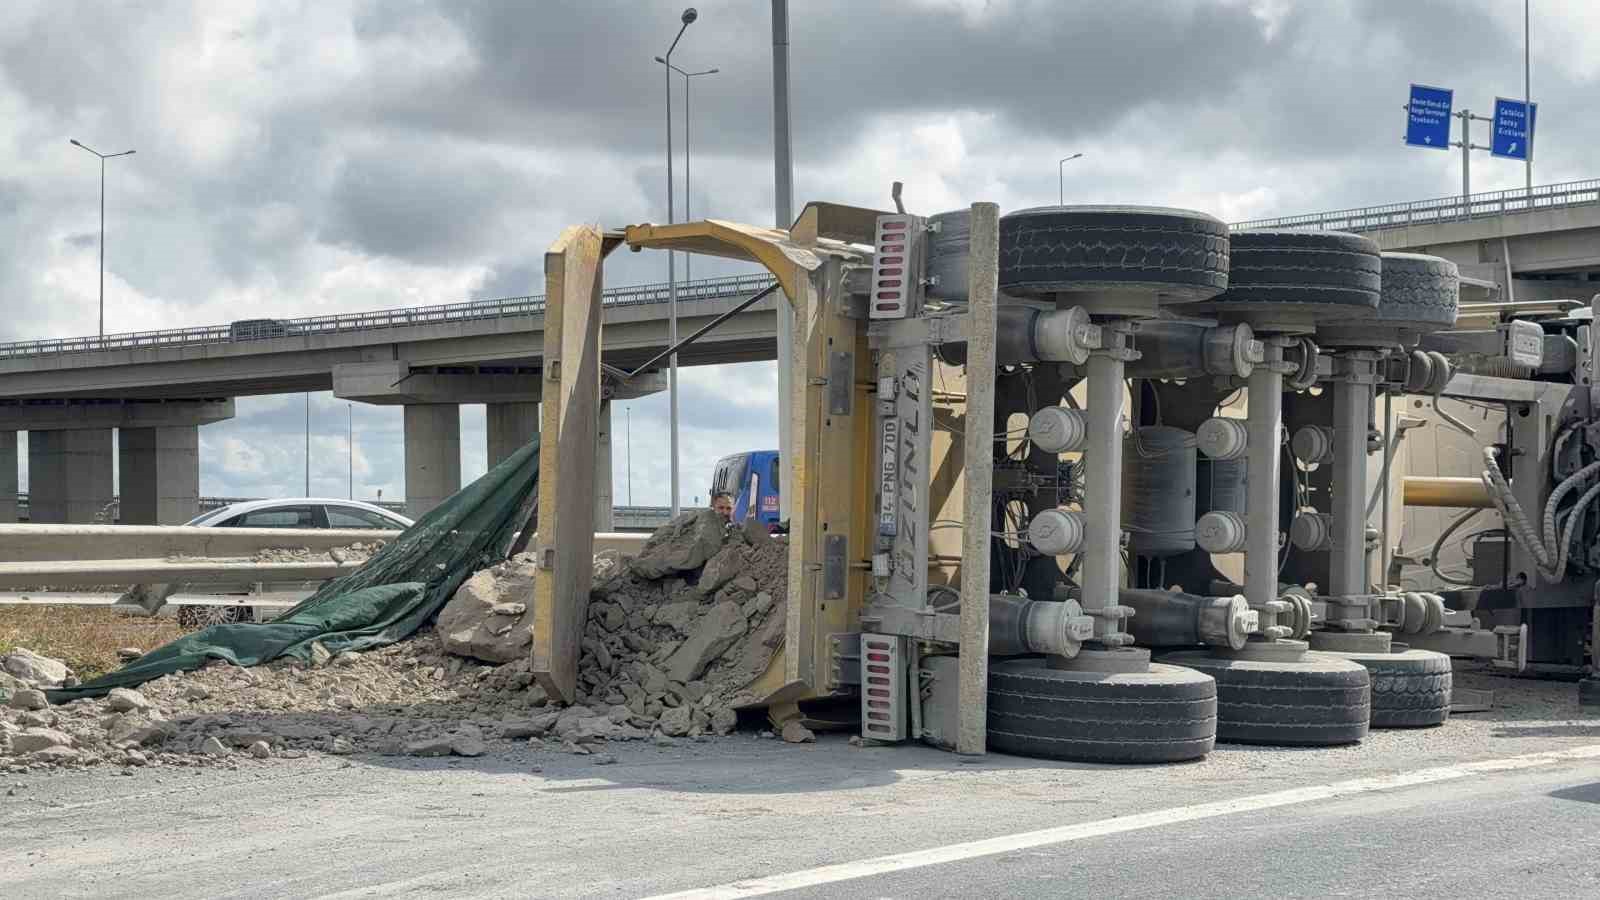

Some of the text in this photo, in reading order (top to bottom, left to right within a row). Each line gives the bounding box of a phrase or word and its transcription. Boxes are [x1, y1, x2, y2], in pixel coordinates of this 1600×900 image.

[882, 422, 898, 522] 34 PNG 700
